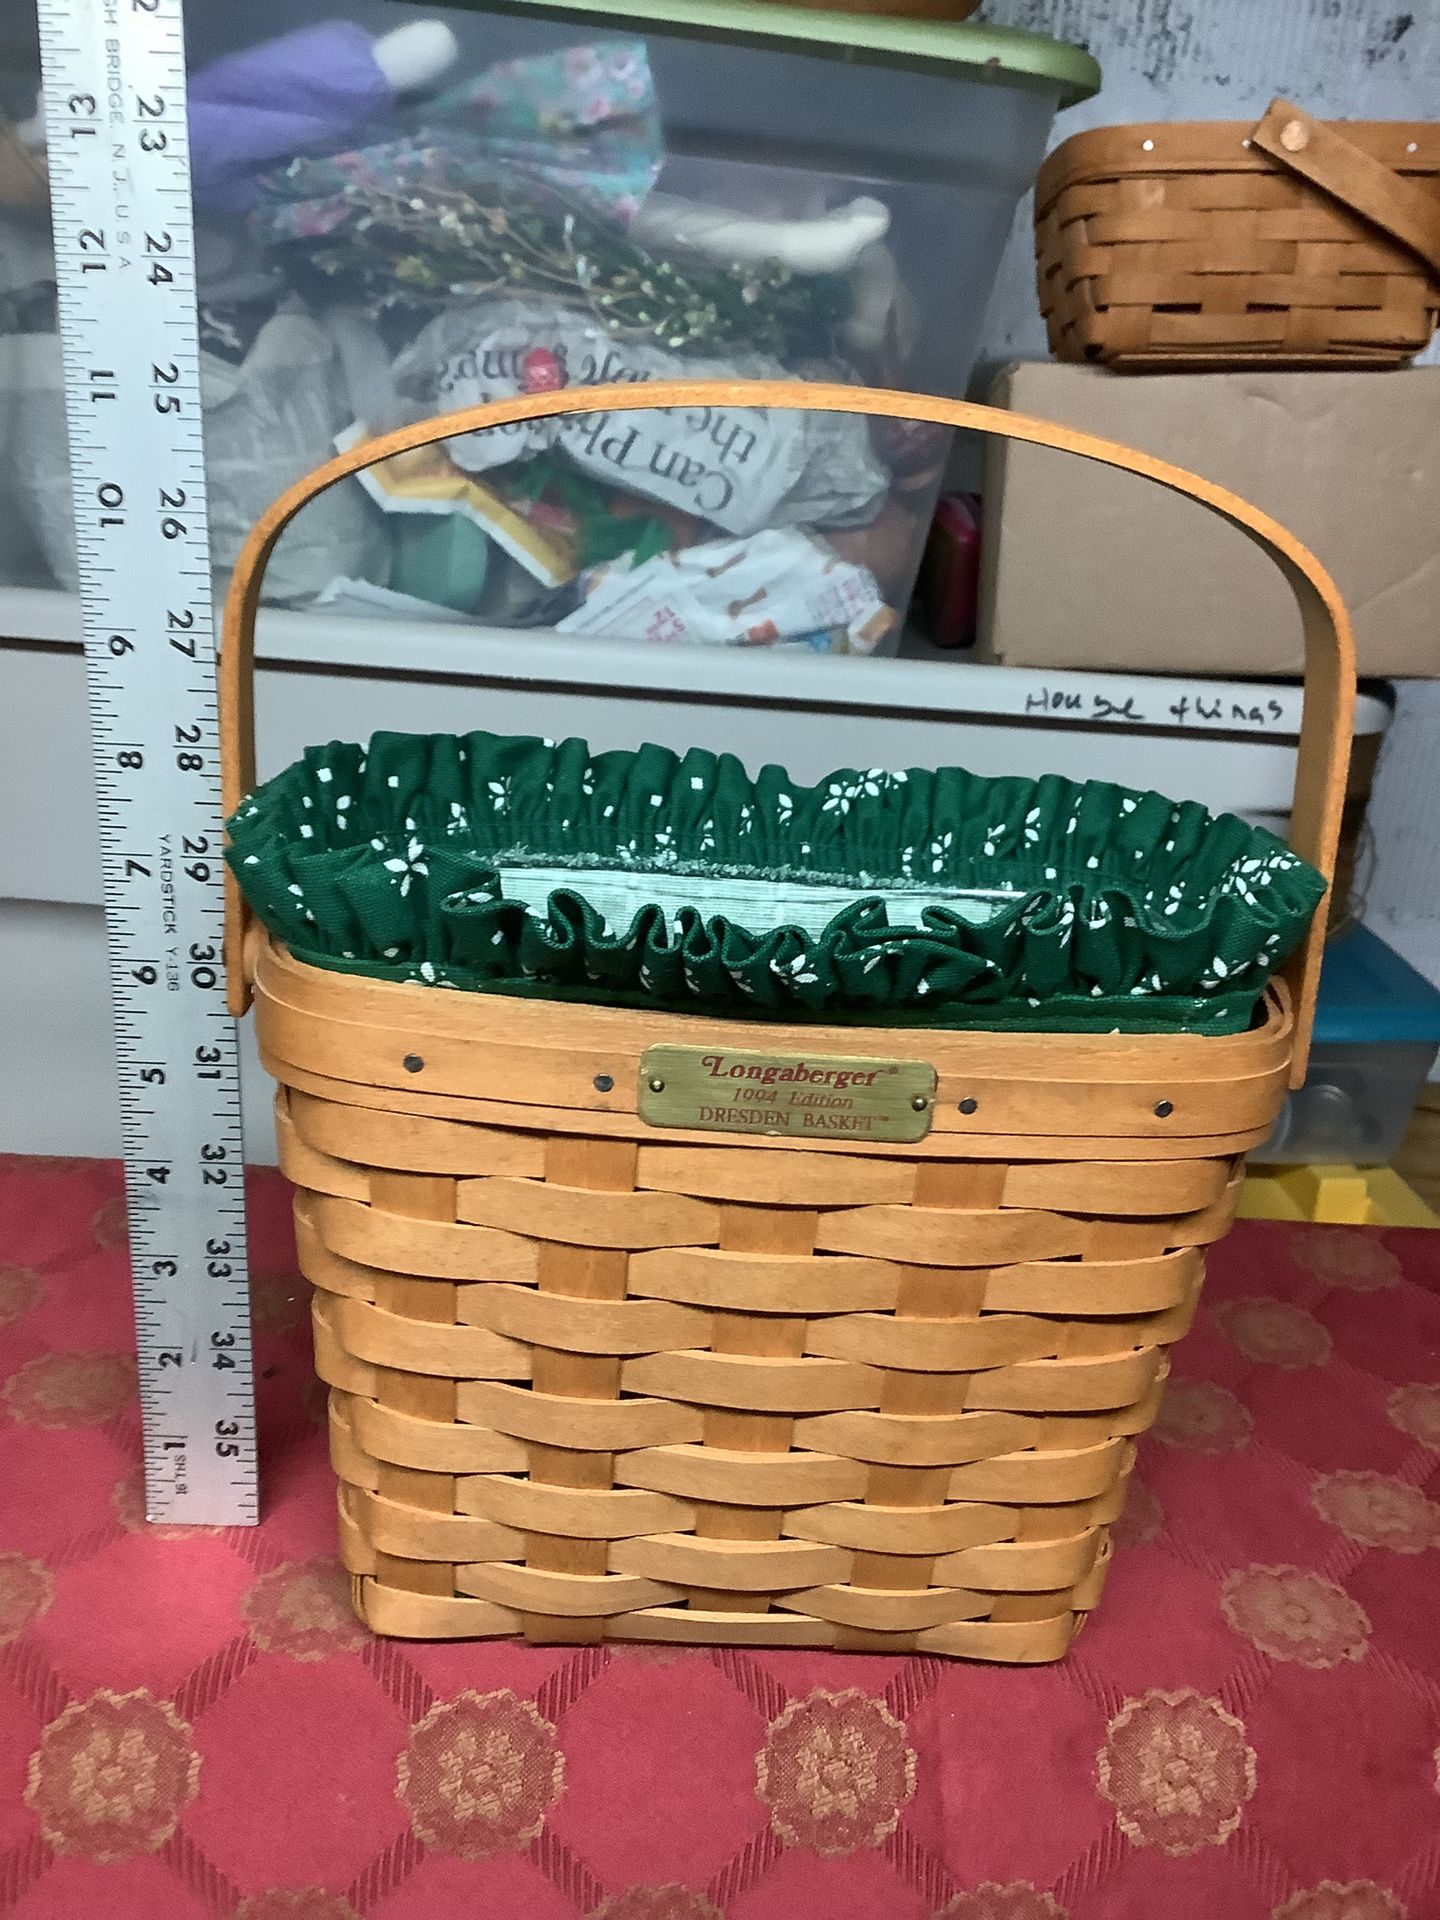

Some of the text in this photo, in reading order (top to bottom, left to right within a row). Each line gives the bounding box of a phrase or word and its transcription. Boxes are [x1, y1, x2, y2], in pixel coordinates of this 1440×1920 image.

[68, 94, 97, 138] 13
[137, 94, 167, 152] 23
[78, 229, 107, 273] 12
[144, 231, 173, 286] 24
[89, 369, 116, 402] 11
[152, 362, 181, 414] 25
[649, 443, 733, 512] Can
[97, 482, 124, 527] 10
[159, 487, 188, 540] 26
[167, 609, 195, 658] 27
[117, 751, 143, 769] 8
[175, 724, 203, 771] 28
[125, 859, 151, 877] 7
[182, 835, 210, 882] 29
[158, 833, 178, 934] YARDSTICK
[189, 943, 216, 989] 30
[140, 1068, 166, 1085] 5
[196, 1045, 221, 1079] 31
[699, 1106, 790, 1127] DRESDEN
[788, 1091, 854, 1109] Edition
[147, 1166, 170, 1184] 4
[201, 1144, 227, 1185] 32
[152, 1260, 177, 1277] 3
[206, 1239, 232, 1278] 33
[158, 1352, 182, 1368] 2
[211, 1331, 236, 1370] 34
[163, 1441, 186, 1451] 1
[215, 1419, 239, 1457] 35
